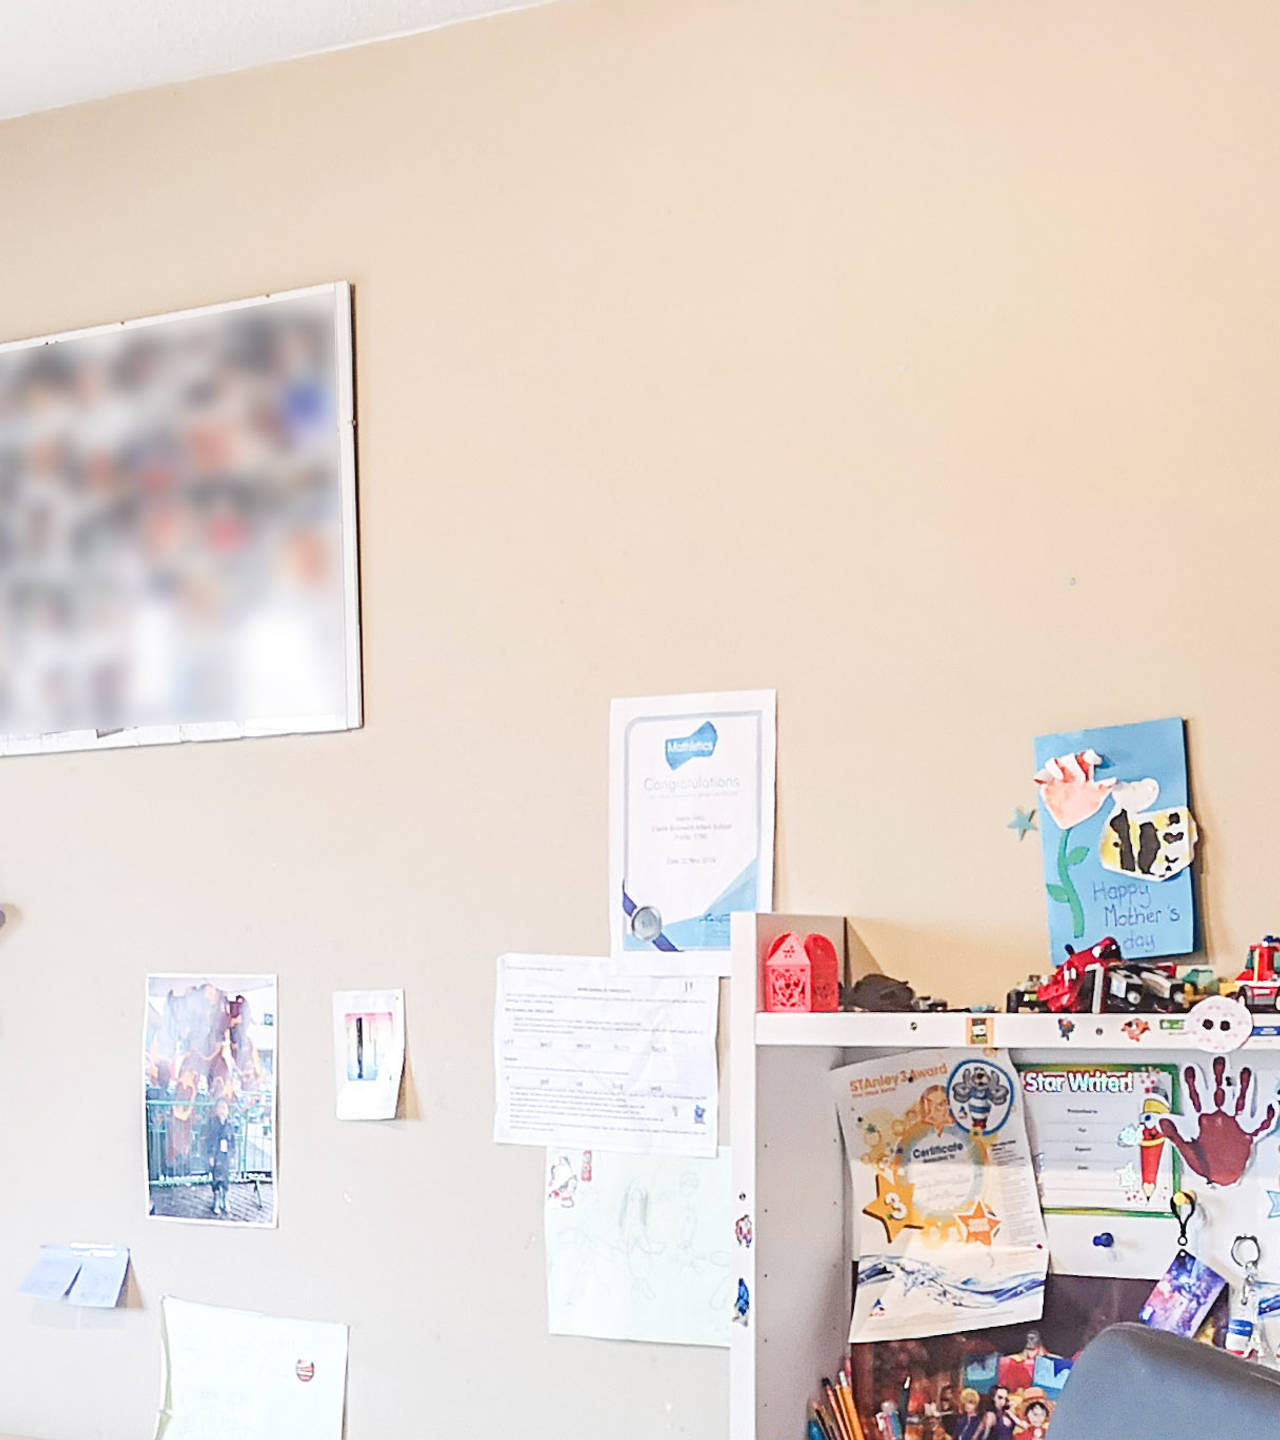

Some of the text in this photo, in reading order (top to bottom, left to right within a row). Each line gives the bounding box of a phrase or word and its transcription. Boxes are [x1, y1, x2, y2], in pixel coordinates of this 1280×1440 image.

[644, 776, 740, 793] Congratulations
[1093, 881, 1152, 908] Happy
[1104, 903, 1181, 927] Mother's
[1122, 931, 1156, 952] day
[900, 1070, 908, 1083] 3
[910, 1063, 948, 1081] Award
[1024, 1069, 1065, 1093] Star
[913, 1142, 964, 1159] Certificate
[884, 1192, 908, 1221] 3
